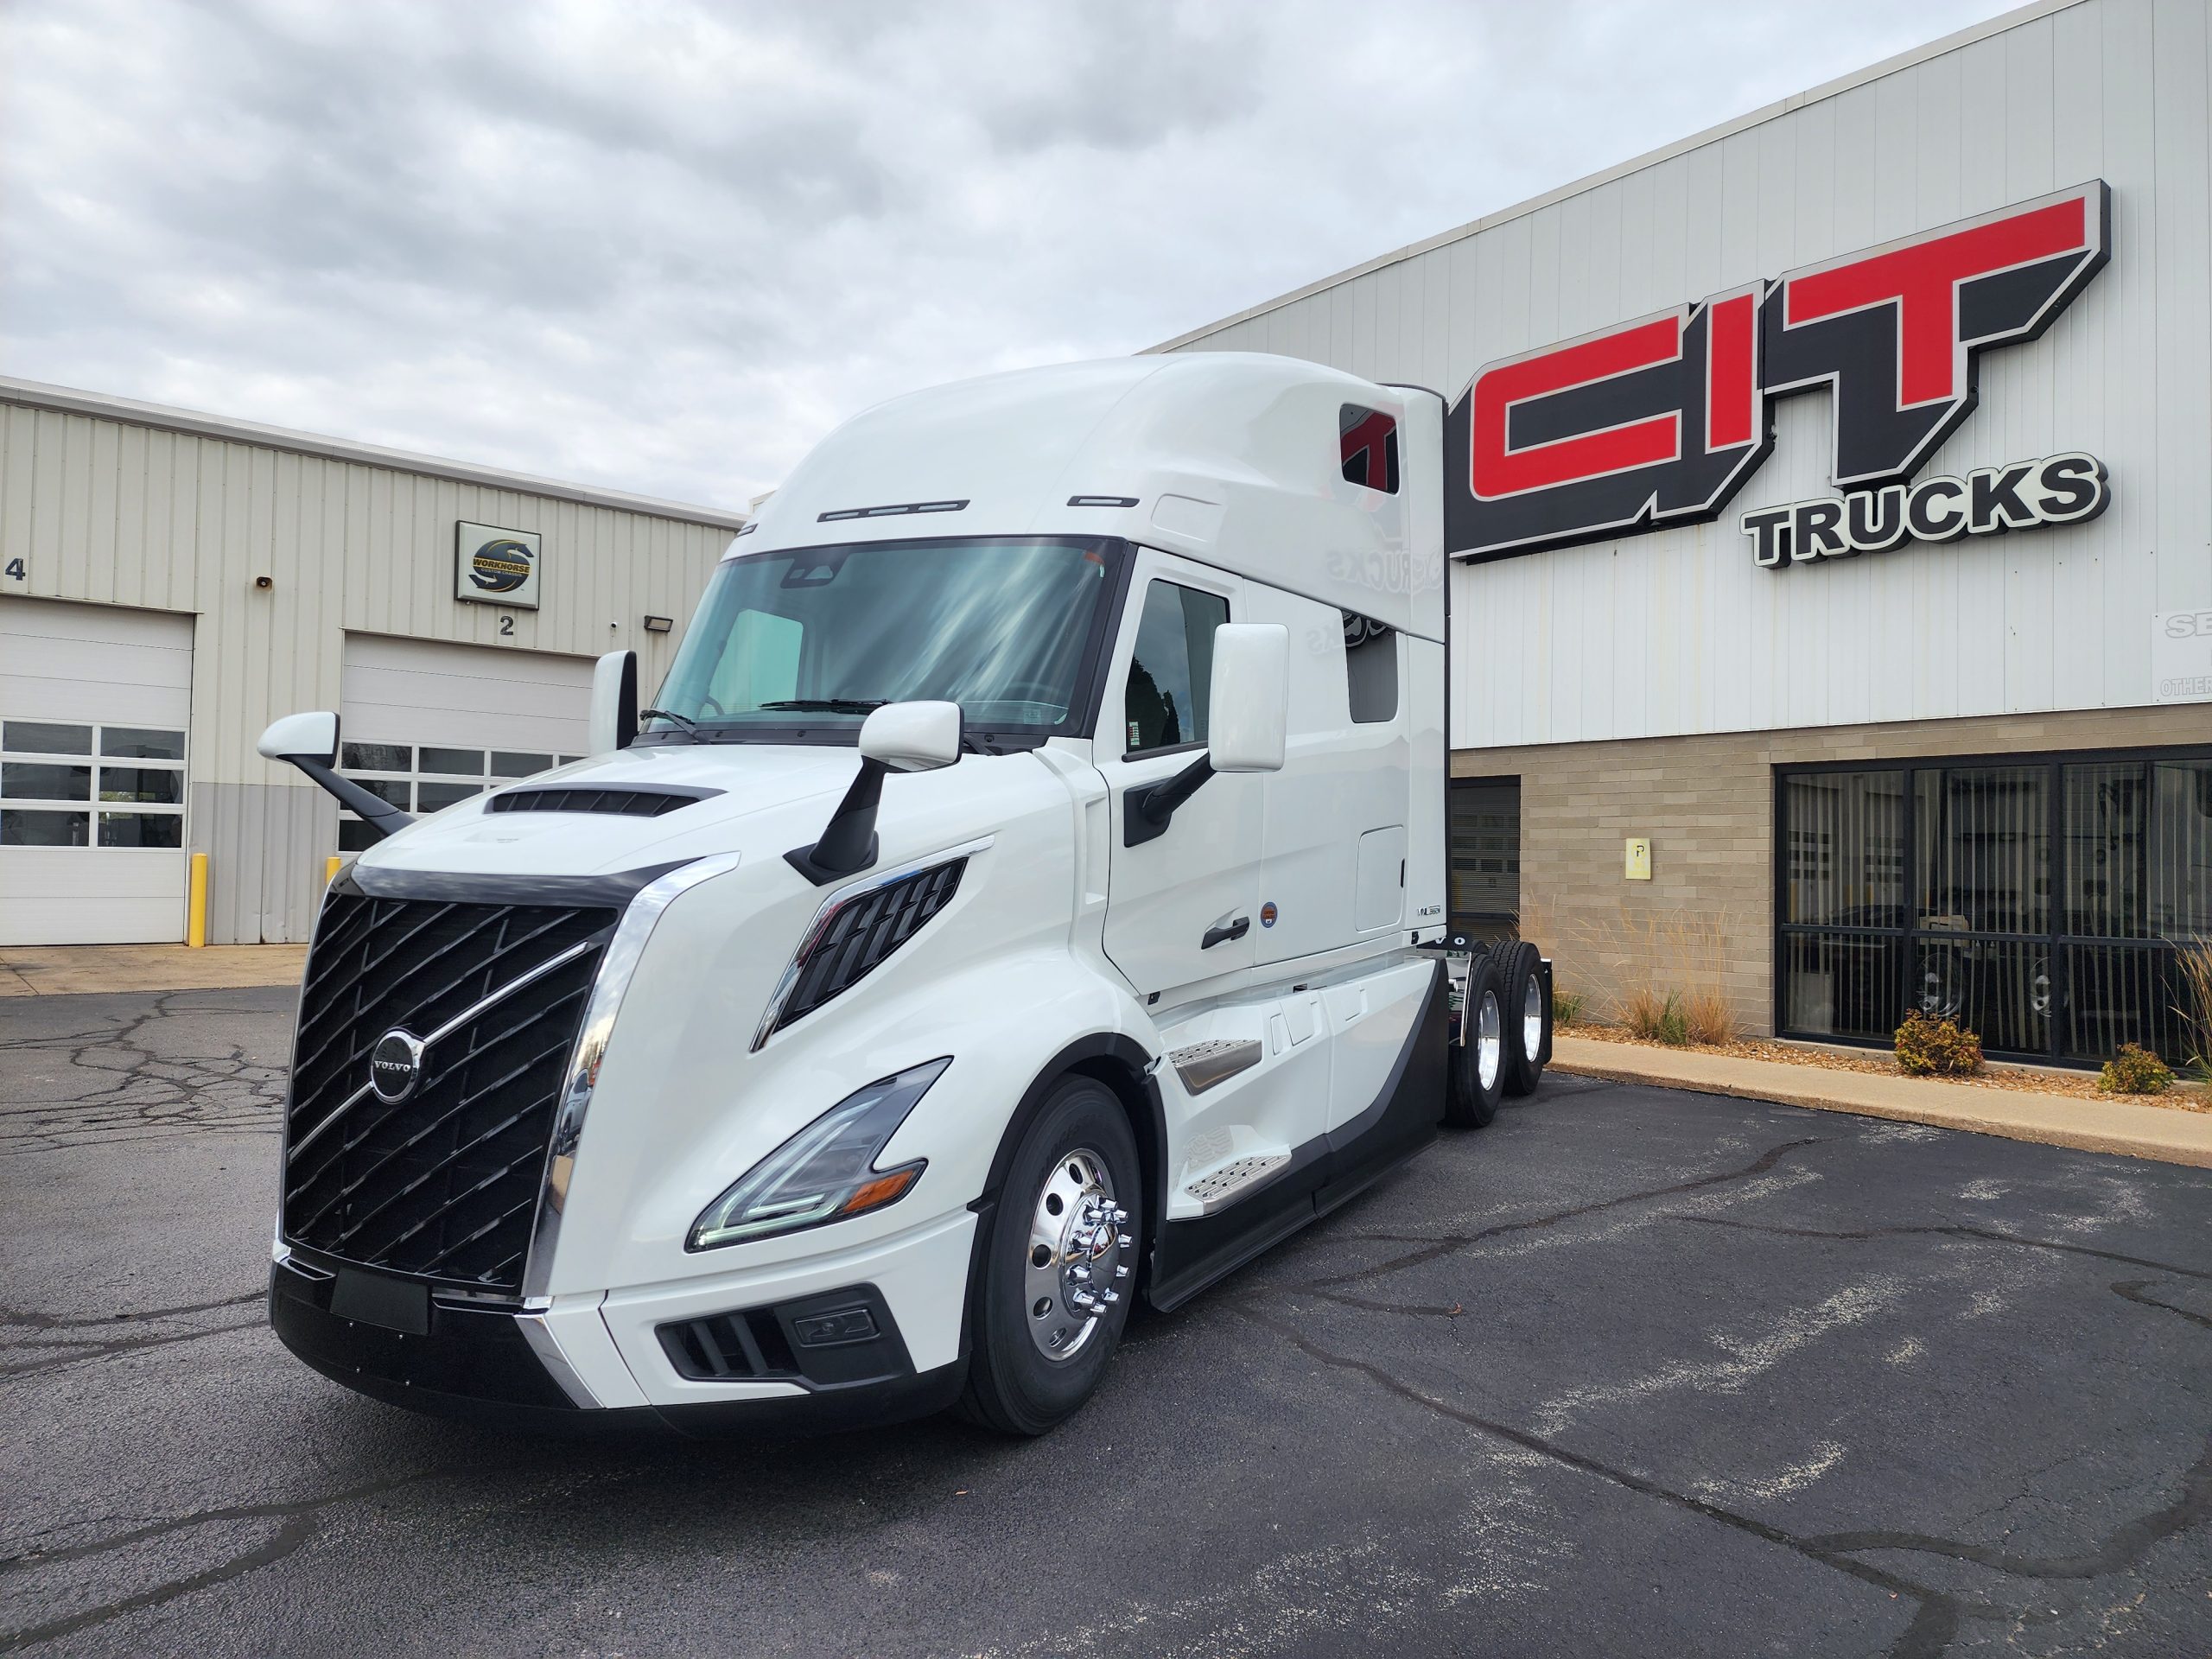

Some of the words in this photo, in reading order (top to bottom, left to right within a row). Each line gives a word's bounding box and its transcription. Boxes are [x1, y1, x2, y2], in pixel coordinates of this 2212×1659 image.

[1469, 183, 2100, 505] CIT
[1742, 454, 2105, 566] TRUCKS
[5, 558, 26, 581] 4
[473, 557, 531, 574] WORKHORSE
[499, 615, 514, 636] 2
[374, 1060, 411, 1072] VOLVO
